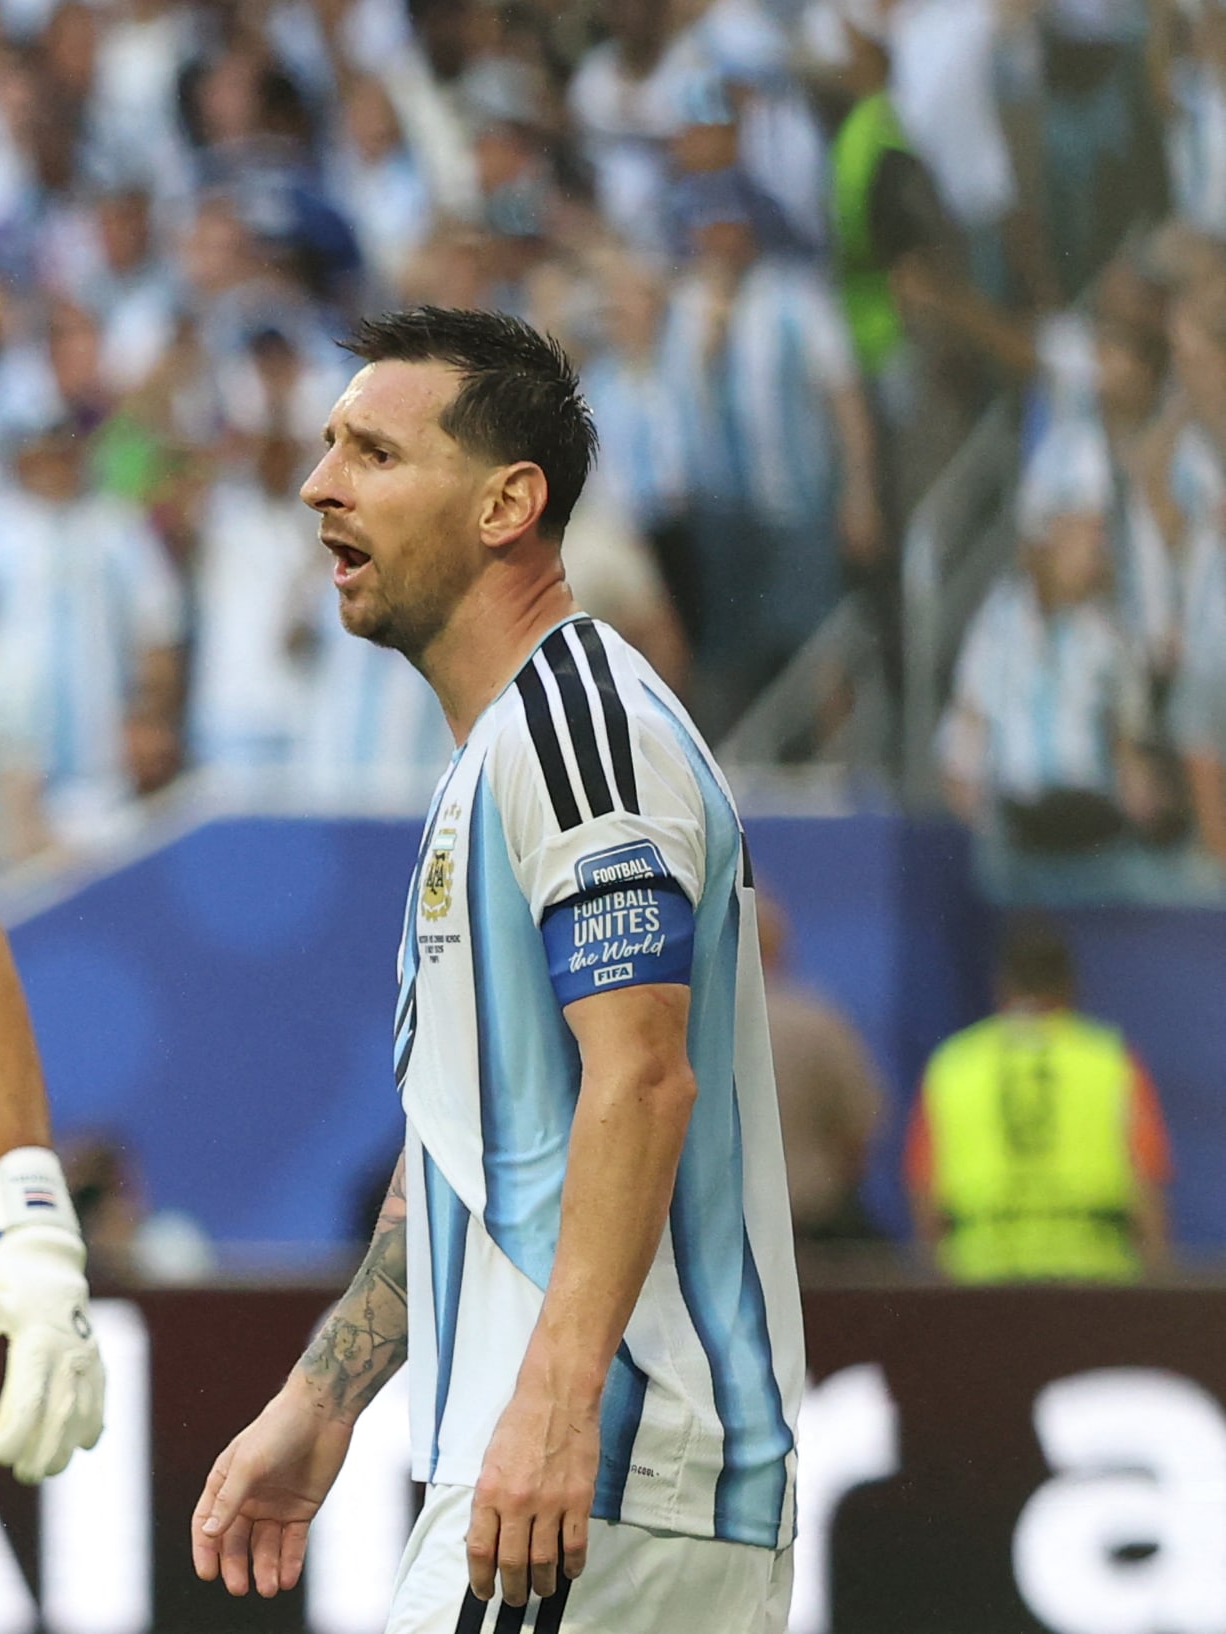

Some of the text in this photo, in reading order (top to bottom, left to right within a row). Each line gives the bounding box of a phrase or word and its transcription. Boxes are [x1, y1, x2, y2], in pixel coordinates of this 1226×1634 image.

[592, 857, 653, 886] FOOTBALL
[574, 888, 659, 921] FOOTBALL
[574, 907, 660, 947] UNITES
[567, 932, 665, 973] the World
[597, 966, 630, 982] FIFA
